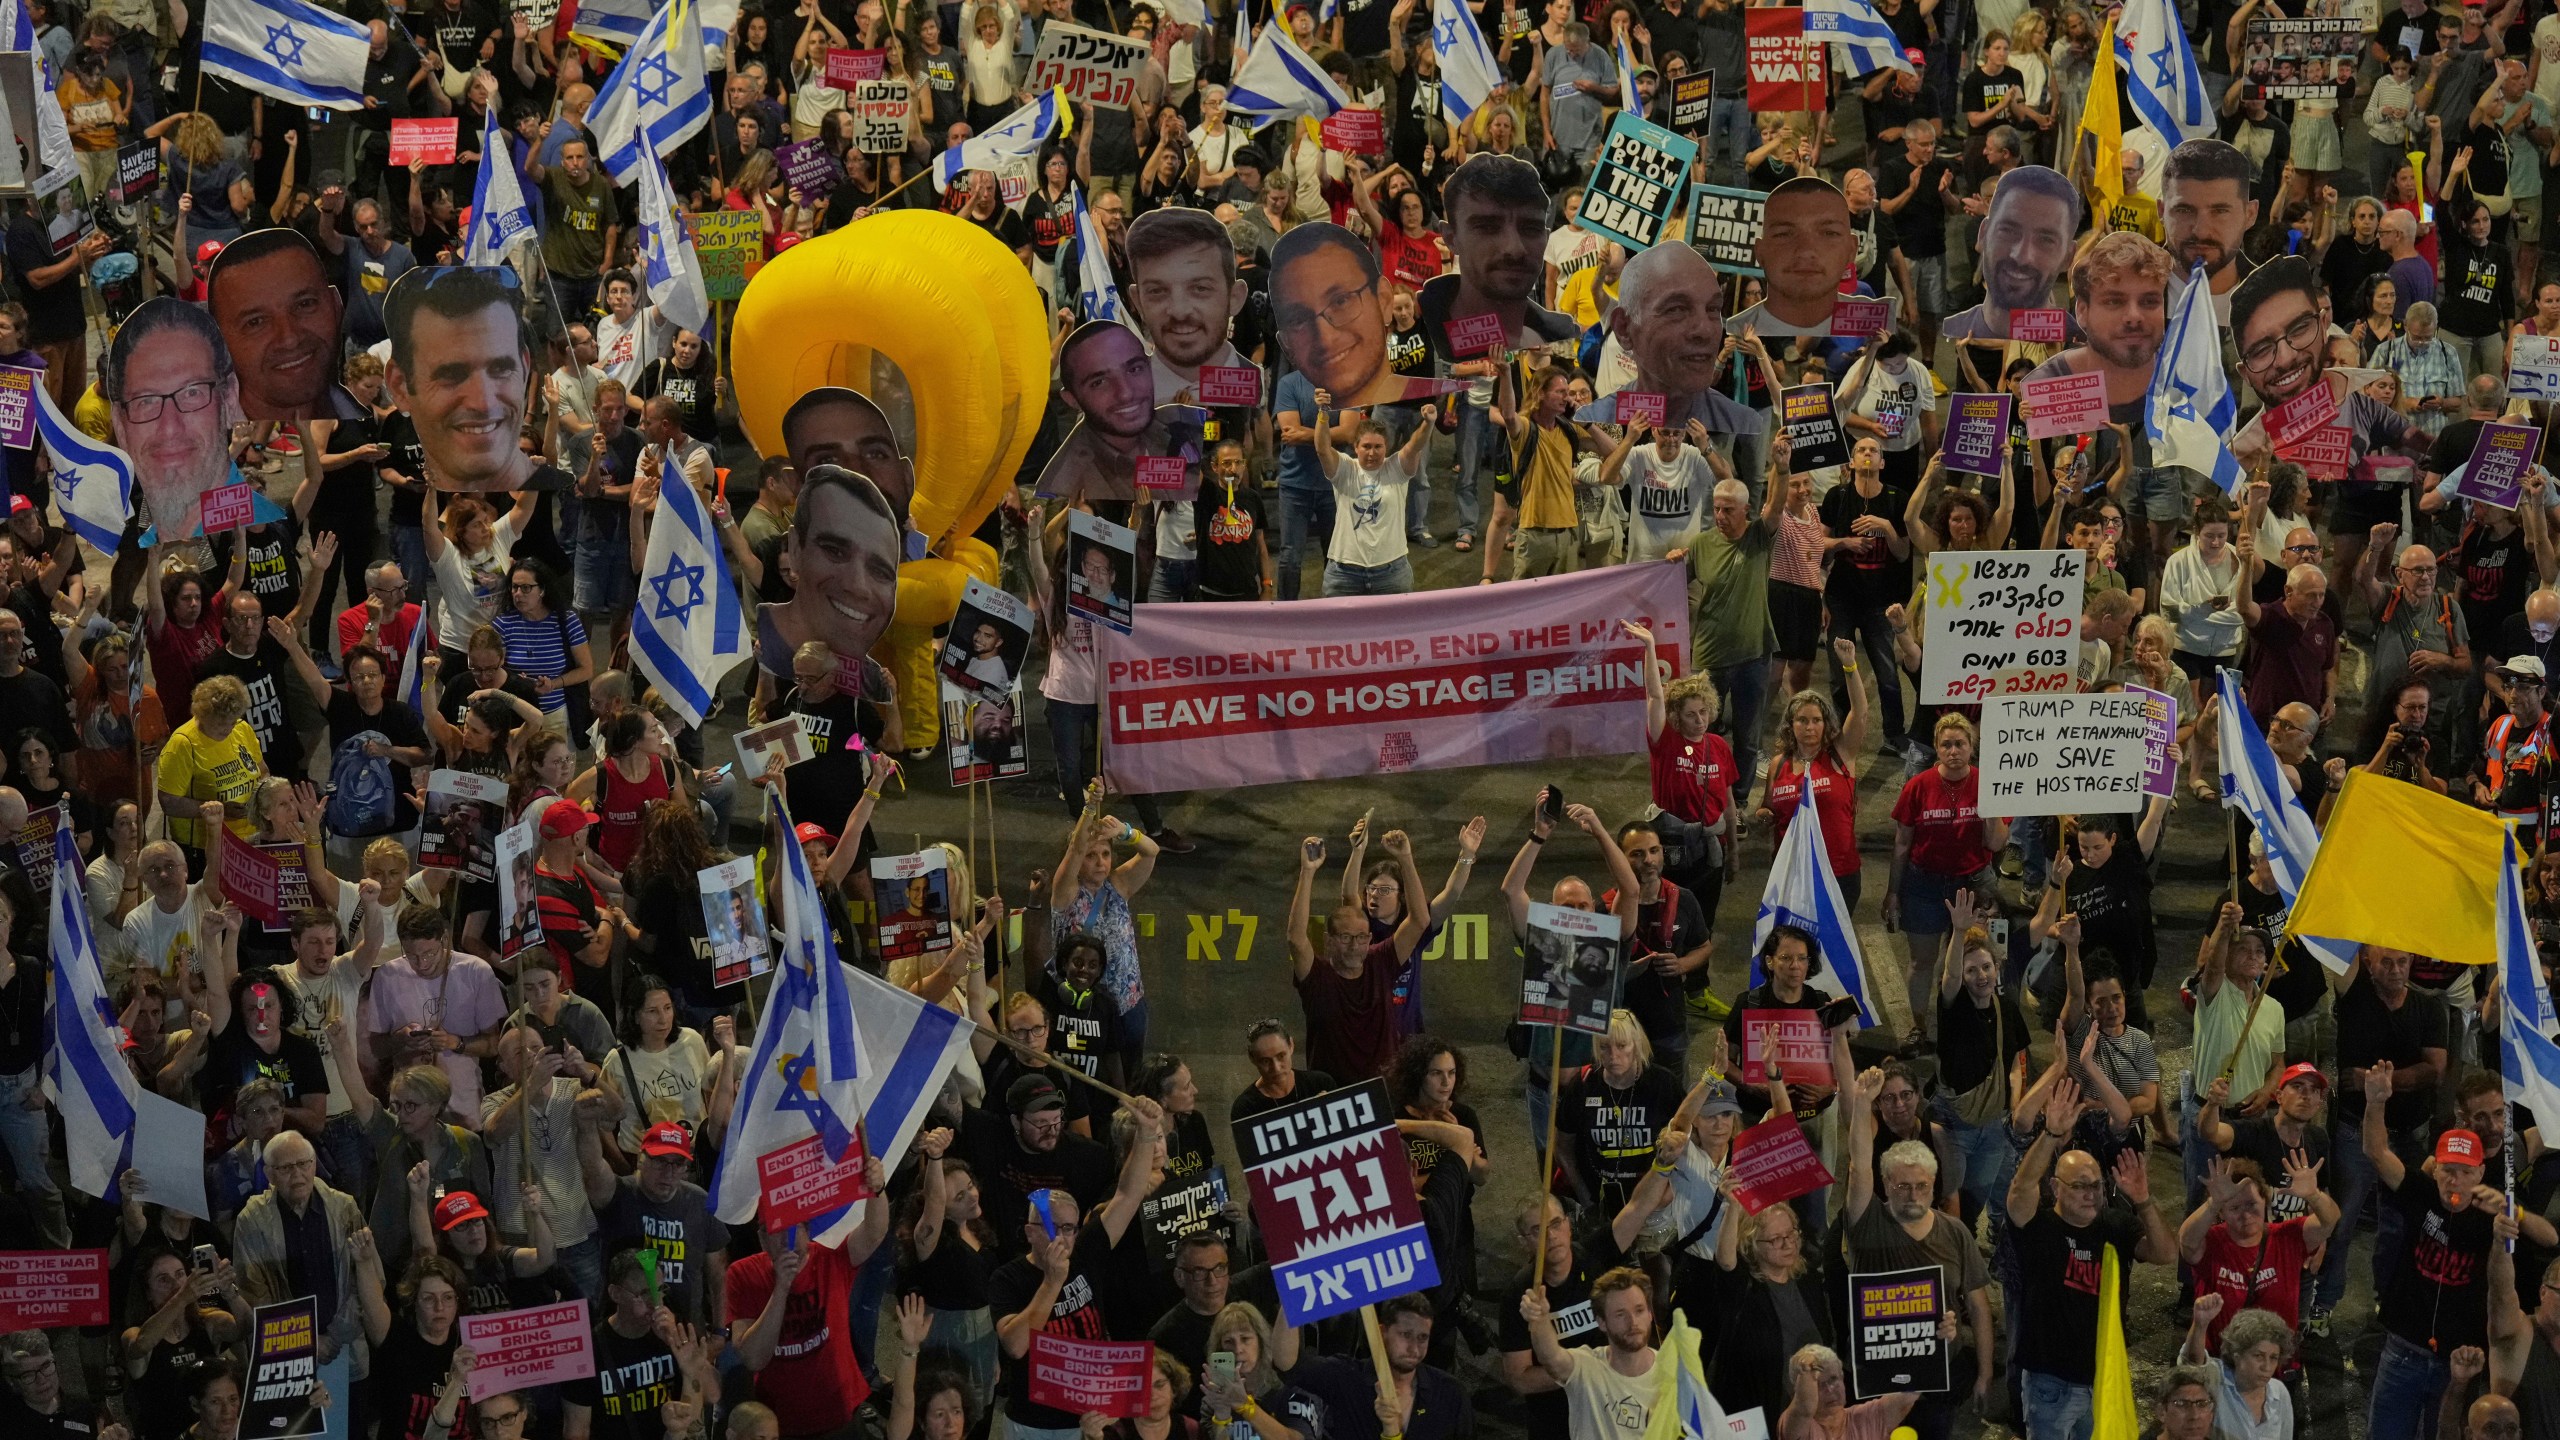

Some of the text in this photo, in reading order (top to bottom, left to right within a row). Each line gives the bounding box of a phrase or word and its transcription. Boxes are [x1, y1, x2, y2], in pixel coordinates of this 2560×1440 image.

[2269, 20, 2364, 33] את כולם בהסכם
[1749, 36, 1782, 48] END
[1048, 34, 1145, 69] יאללה,
[1750, 64, 1821, 83] WAR
[1032, 60, 1135, 105] הביתה!
[859, 85, 907, 101] כולם!
[2258, 85, 2338, 99] עכשיו!
[1675, 98, 1708, 114] מסרבים
[1335, 121, 1360, 130] BRING
[1355, 114, 1375, 122] WAR
[865, 119, 903, 136] בכל
[1350, 130, 1375, 138] THEM
[855, 136, 903, 151] מחיר!
[1337, 138, 1362, 147] HOME
[121, 147, 156, 171] SAVE THE
[790, 145, 812, 165] לא
[1613, 148, 1679, 188] BLOW
[1608, 167, 1661, 211] THE
[1700, 195, 1738, 219] את
[1584, 191, 1653, 244] DEAL
[1849, 306, 1884, 317] עדיין
[2026, 312, 2062, 325] עדיין
[1460, 314, 1497, 333] עדיין
[1459, 329, 1503, 349] בעזה.
[1217, 368, 1255, 382] עדיין
[665, 378, 682, 390] GET
[1208, 384, 1255, 398] בעזה.
[2030, 377, 2099, 393] END THE WAR
[663, 389, 696, 403] PEOPLE
[1630, 394, 1663, 407] עדיין
[1786, 393, 1826, 407] מצילים את
[2049, 391, 2082, 403] BRING
[2286, 383, 2327, 420] עדיין
[1786, 403, 1828, 419] החטופים
[2034, 400, 2099, 417] ALL THEM
[1786, 419, 1834, 436] מסרבים
[2052, 414, 2085, 426] HOME
[2286, 402, 2335, 441] בעזה.
[1791, 430, 1837, 449] למלחמה
[2493, 439, 2524, 448] הסכמים
[1958, 444, 1990, 456] חיים
[2487, 453, 2519, 464] מצילים
[1149, 460, 1183, 471] עדיין
[1140, 473, 1181, 484] בעזה.
[2478, 473, 2509, 487] חיים
[214, 486, 248, 504] עדיין
[1639, 486, 1689, 512] NOW!
[209, 504, 251, 524] בעזה.
[1973, 553, 2079, 579] אל תעשו
[1071, 572, 1089, 587] BRING
[1071, 582, 1083, 595] HIM
[1949, 611, 2072, 639] כולם אחרי
[947, 643, 967, 661] BRING
[1107, 616, 1653, 684] PRESIDENT TRUMP, END THE WAR
[944, 654, 957, 668] HIM
[1961, 649, 2067, 670] 603 ימים
[2005, 670, 2068, 693] במצב
[1118, 673, 1515, 732] LEAVE NO HOSTAGE
[2001, 699, 2147, 719] TRUMP PLEASE
[1384, 731, 1411, 739] מחאת
[1384, 738, 1413, 747] הנשים
[1998, 725, 2145, 744] DITCH NETANYAHU
[952, 758, 967, 769] HIM
[1999, 746, 2116, 771] AND SAVE
[1992, 771, 2140, 797] THE HOSTAGES!
[422, 832, 445, 844] BRING
[421, 842, 436, 853] HIM
[223, 839, 271, 881] עד החטוף
[224, 866, 263, 898] האחרון
[281, 896, 312, 908] חיים
[879, 925, 901, 938] BRING
[1187, 908, 1258, 961] לא
[881, 935, 895, 946] HIM
[1524, 980, 1549, 994] BRING
[1524, 992, 1546, 1005] THEM
[1057, 1014, 1101, 1038] חטופים
[1252, 1092, 1375, 1156] נתניהו
[767, 1142, 825, 1172] END THE
[2447, 1145, 2471, 1155] WAR
[775, 1161, 860, 1202] ALL OF THEM
[796, 1184, 840, 1210] HOME
[1161, 1178, 1224, 1211] די למלחמה
[1273, 1156, 1391, 1231] נגד
[658, 1219, 684, 1239] למה
[24, 1257, 96, 1269] THE WAR
[16, 1273, 68, 1285] BRING
[1285, 1240, 1427, 1312] ישראל
[26, 1286, 94, 1298] OF THEM
[1863, 1283, 1932, 1302] מצילים את
[17, 1302, 70, 1316] HOME
[1864, 1298, 1933, 1317] החטופים
[264, 1321, 279, 1336] את
[471, 1309, 577, 1336] END THE WAR
[500, 1329, 552, 1348] BRING
[1863, 1321, 1936, 1343] מסרבים
[476, 1340, 579, 1367] ALL OF THEM
[1039, 1340, 1142, 1360] END THE WAR
[1864, 1338, 1936, 1361] למלחמה
[257, 1355, 314, 1383] מסרבים
[504, 1359, 555, 1377] HOME
[1064, 1359, 1114, 1375] BRING
[1041, 1368, 1138, 1390] ALL OF THEM
[253, 1376, 314, 1402] למלחמה
[1063, 1389, 1113, 1406] HOME
